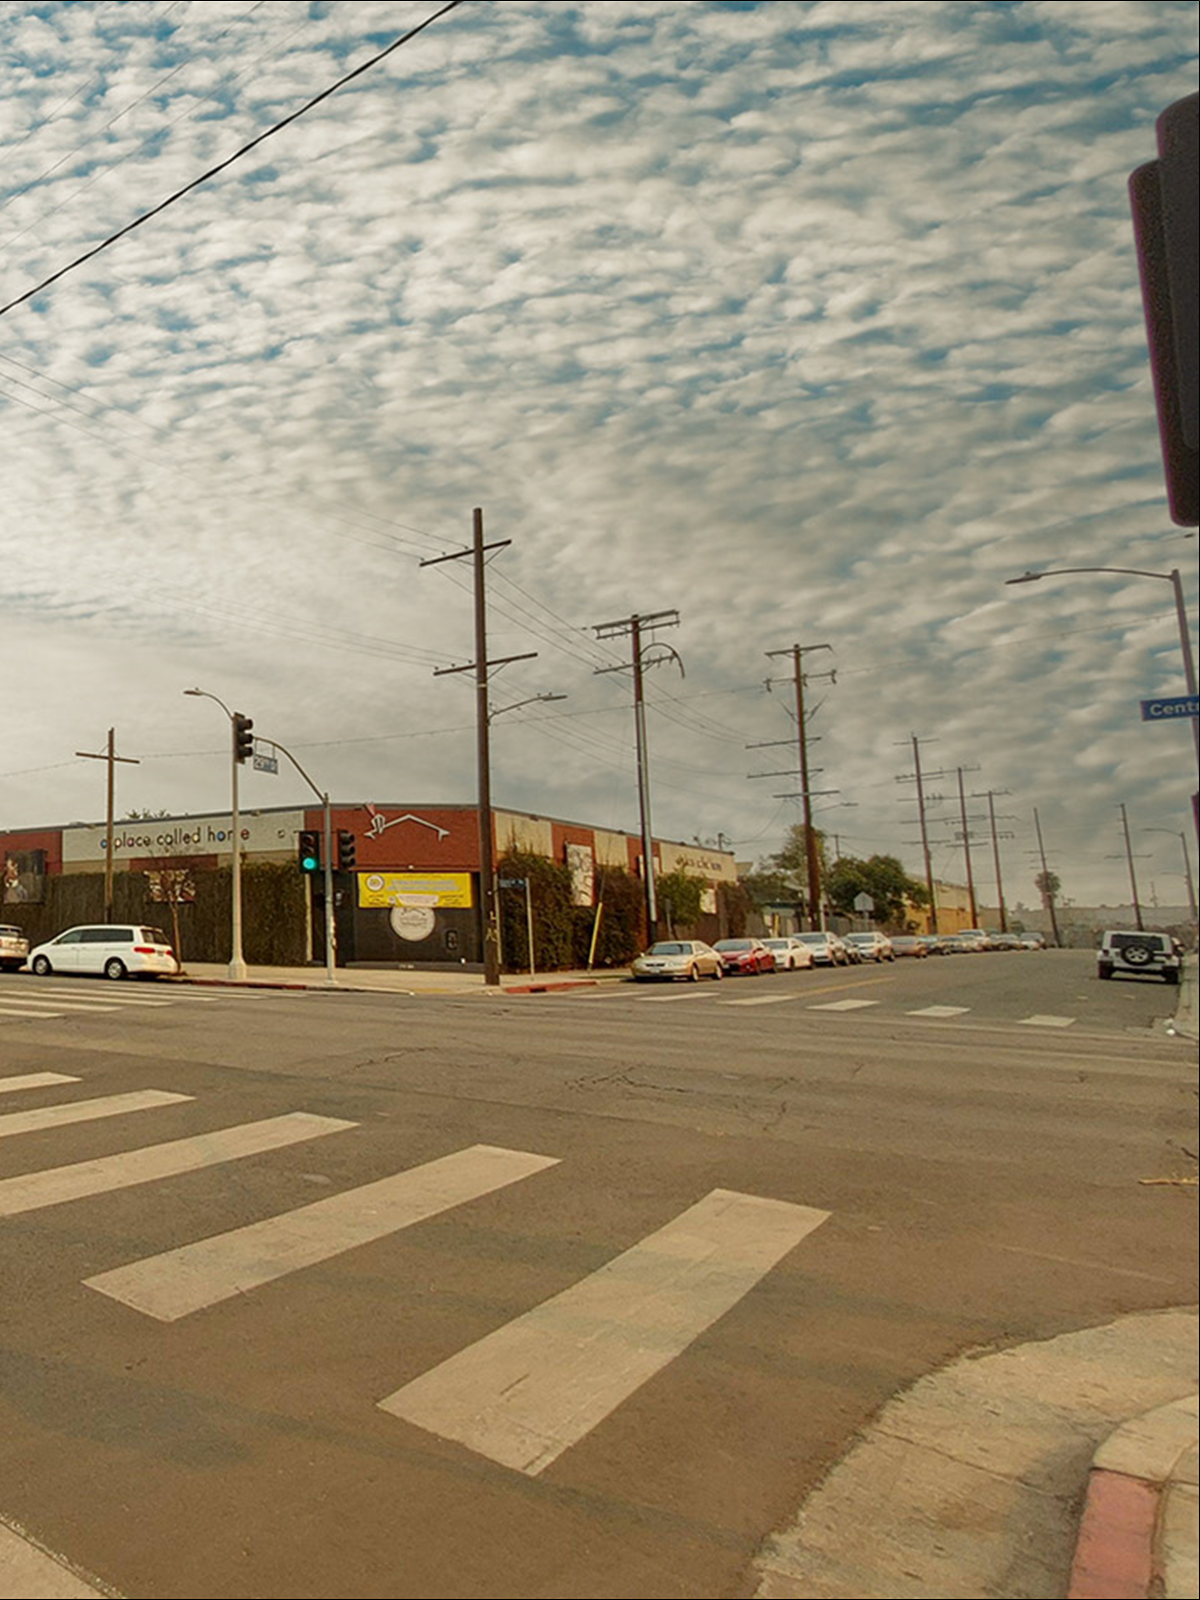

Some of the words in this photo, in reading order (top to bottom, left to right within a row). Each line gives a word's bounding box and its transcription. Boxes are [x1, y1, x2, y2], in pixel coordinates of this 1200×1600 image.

[1150, 701, 1199, 716] Cent
[114, 831, 150, 851] place
[156, 826, 200, 846] called
